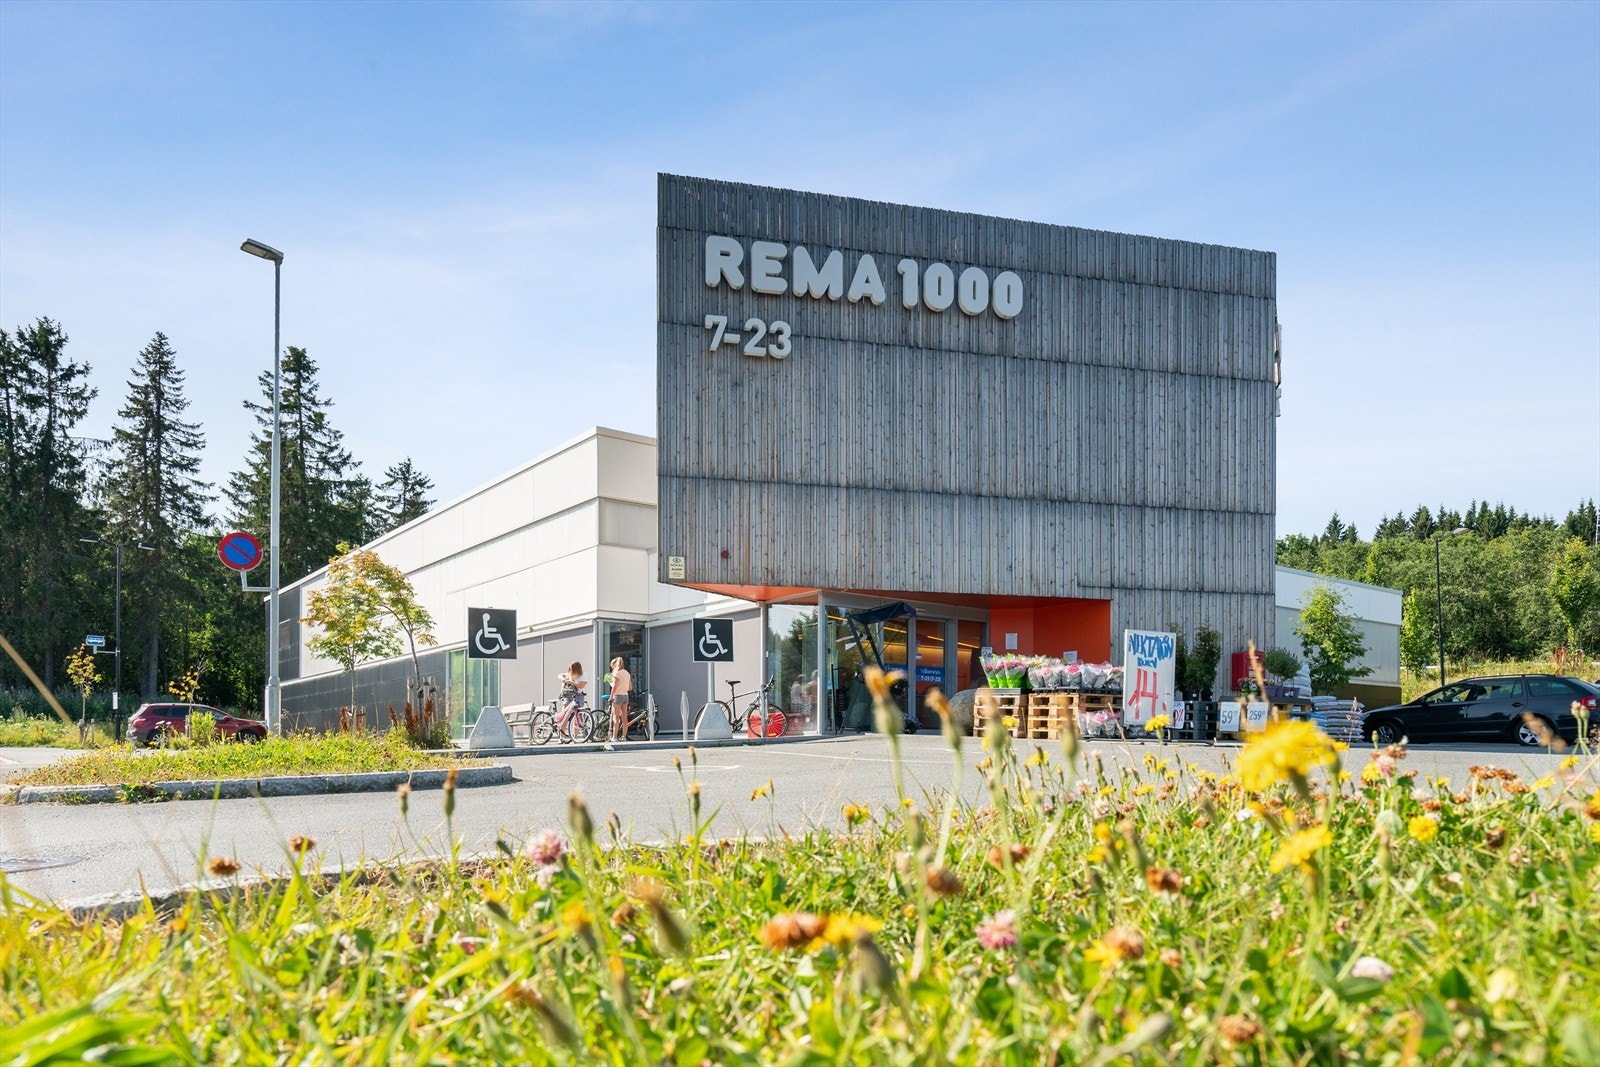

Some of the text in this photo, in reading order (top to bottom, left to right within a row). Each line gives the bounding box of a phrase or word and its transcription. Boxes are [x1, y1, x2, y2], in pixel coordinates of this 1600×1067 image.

[705, 235, 1024, 320] REMA 1000
[704, 314, 792, 359] 7-23
